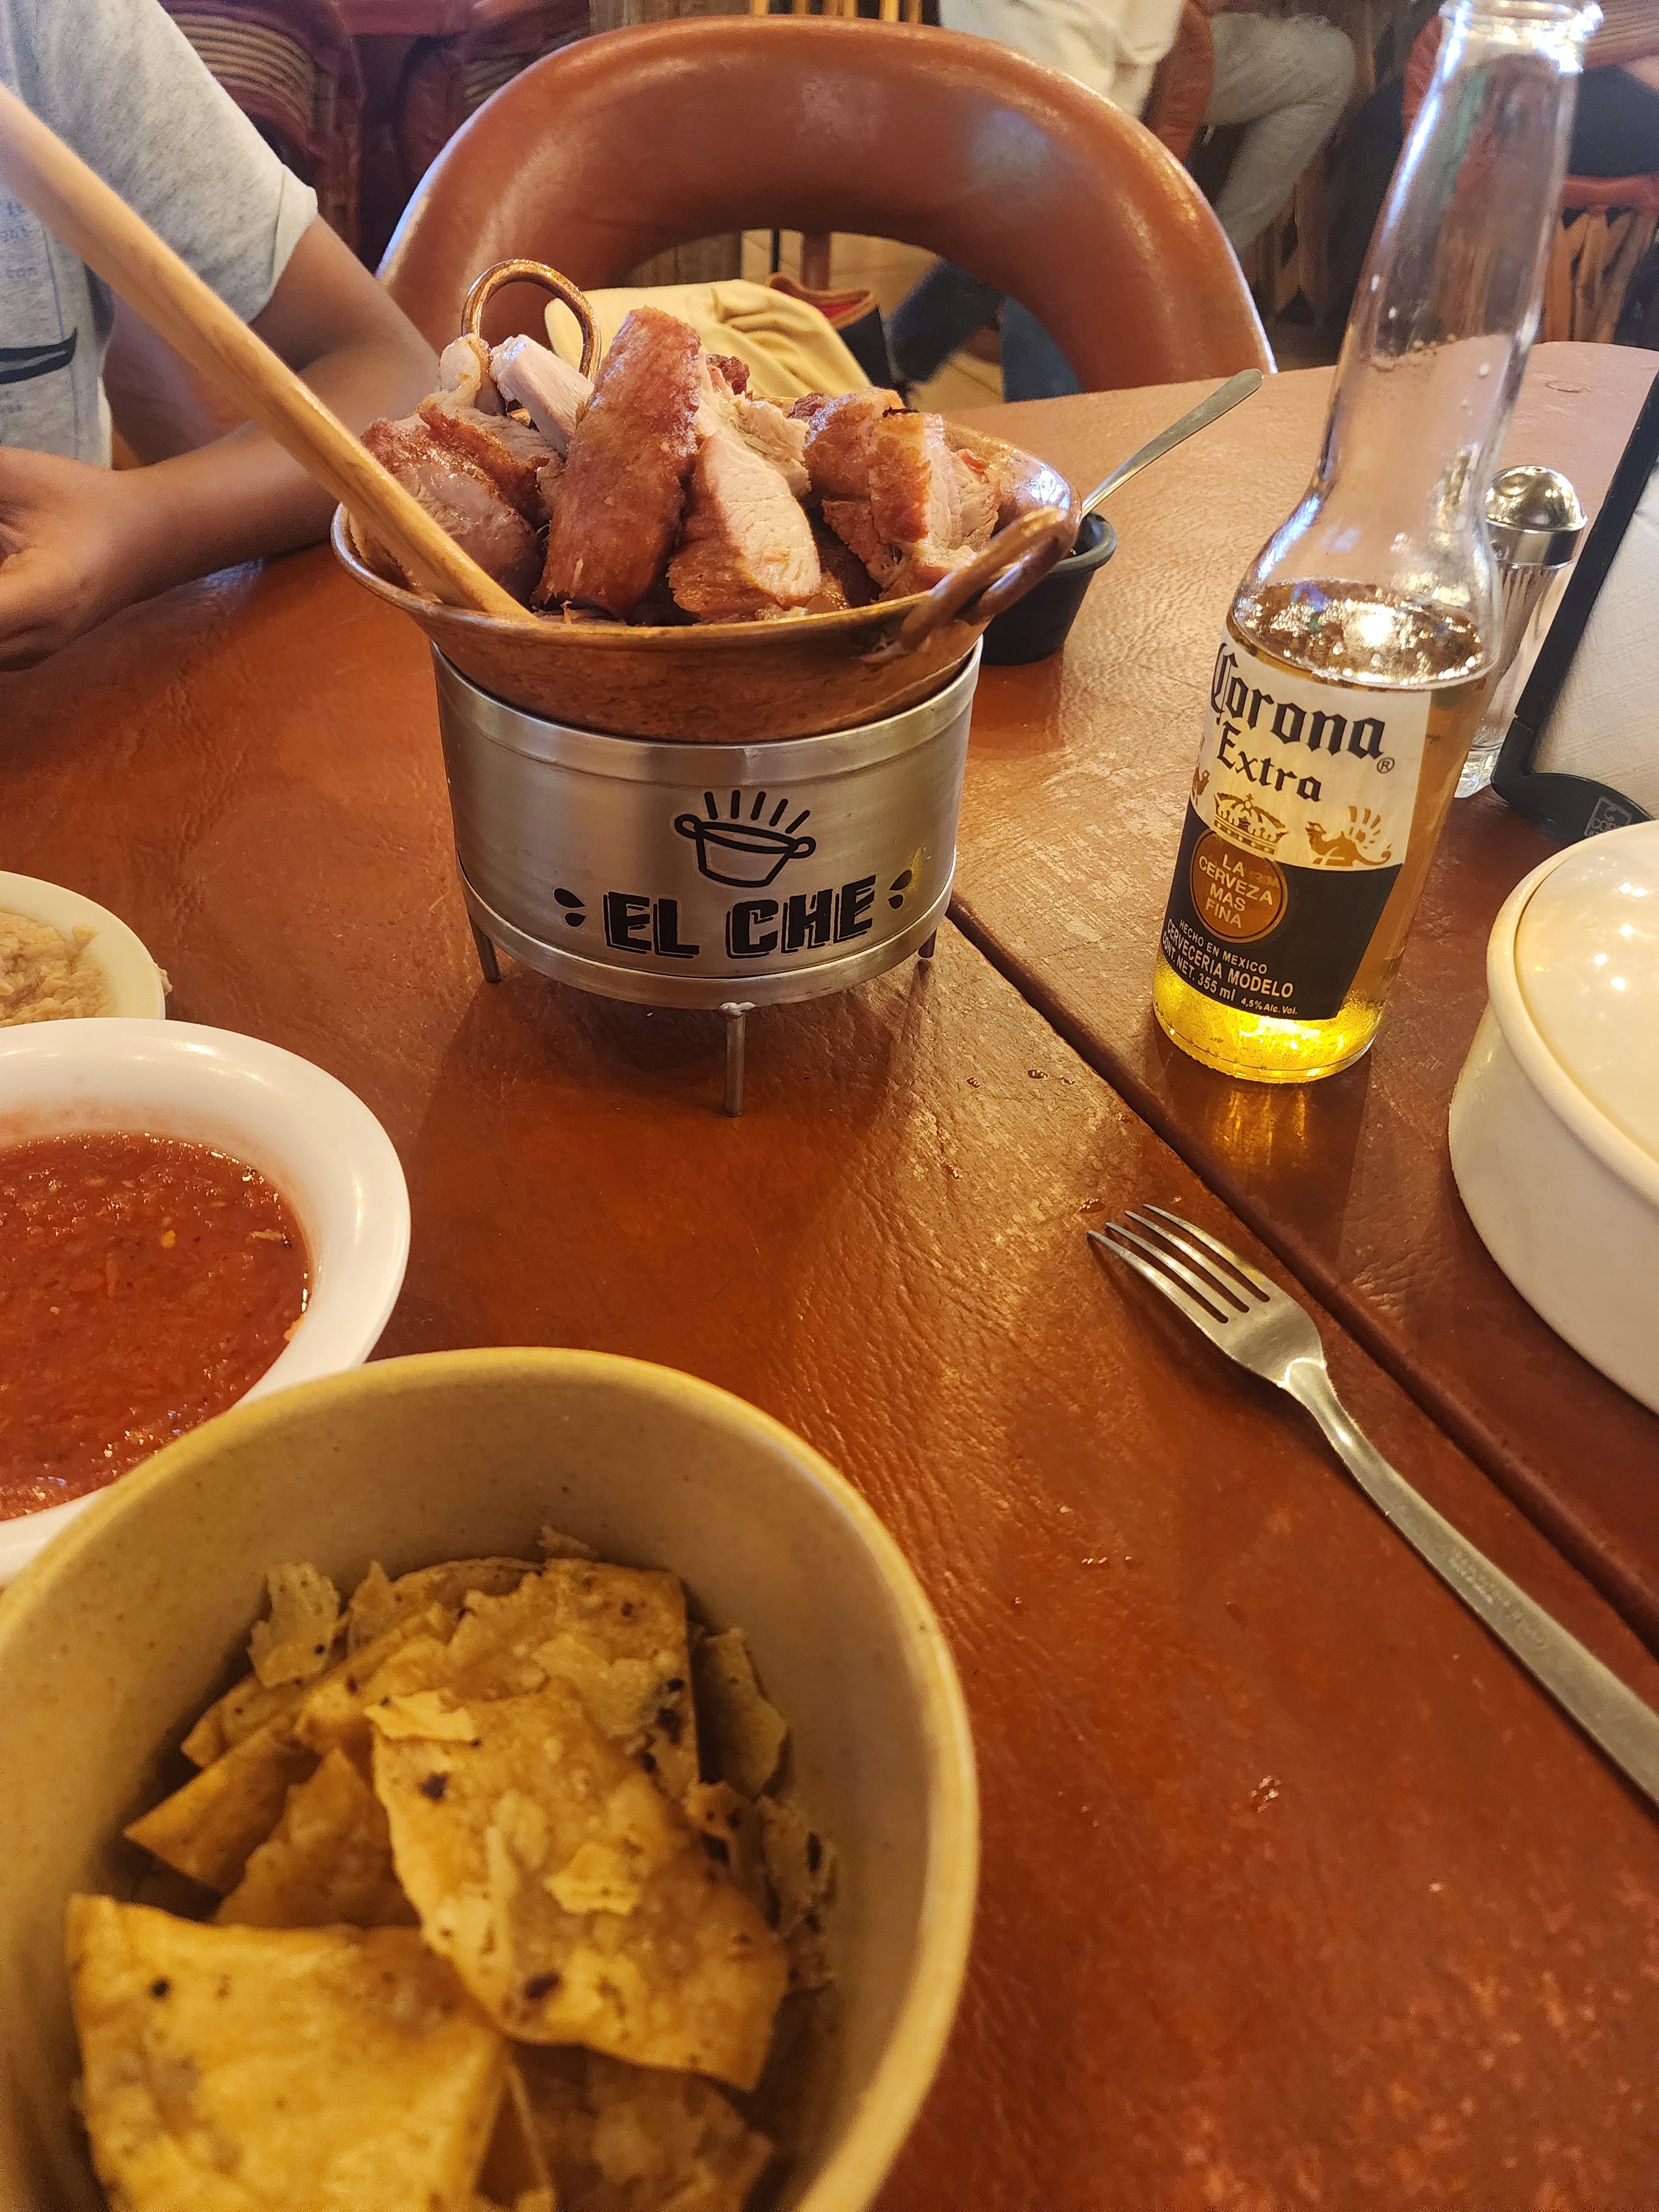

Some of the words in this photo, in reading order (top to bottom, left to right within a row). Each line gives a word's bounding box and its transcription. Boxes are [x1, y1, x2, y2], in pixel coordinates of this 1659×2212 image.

[1211, 643, 1386, 760] Corona
[1217, 721, 1322, 802] Extra
[1199, 855, 1272, 905] CERVEZA
[1223, 854, 1244, 877] LA
[603, 890, 700, 958] EL
[726, 874, 877, 959] CHE
[1206, 898, 1241, 928] FINA
[1209, 883, 1246, 911] MAS
[1162, 931, 1176, 963] CONT.
[1176, 955, 1195, 980] NET.
[1197, 973, 1218, 993] 355
[1219, 987, 1236, 1001] ml
[1167, 918, 1222, 979] CERVECERIA
[1228, 968, 1293, 998] MODELO
[1179, 919, 1204, 947] HECHO
[1206, 942, 1220, 957] EN
[1222, 950, 1267, 974] MEXICO
